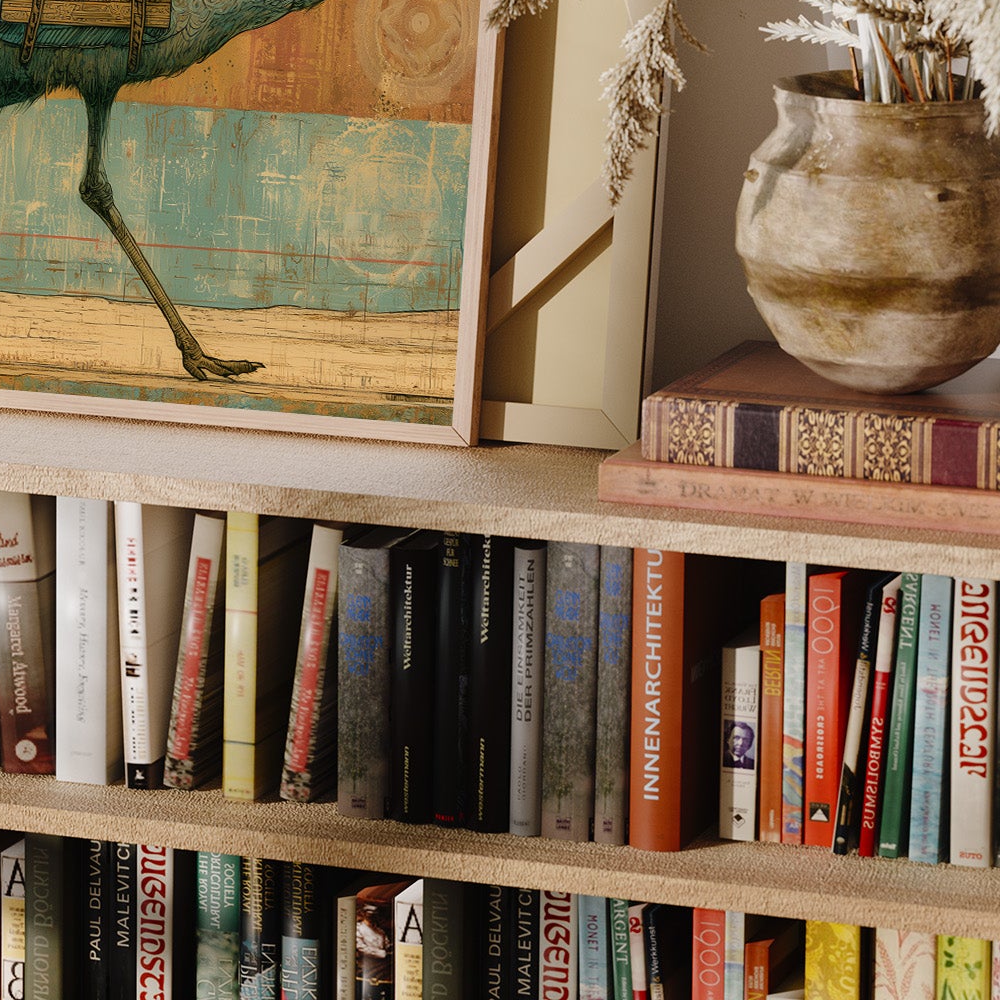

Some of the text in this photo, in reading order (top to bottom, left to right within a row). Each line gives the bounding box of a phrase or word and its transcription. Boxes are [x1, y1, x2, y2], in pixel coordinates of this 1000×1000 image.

[403, 564, 413, 672] Weltarchitektur
[524, 559, 535, 723] DER PRIMZAHLEN
[89, 915, 102, 962] PAUL
[588, 915, 597, 953] MONET
[614, 899, 629, 965] ARGENT
[694, 921, 721, 988] 1900
